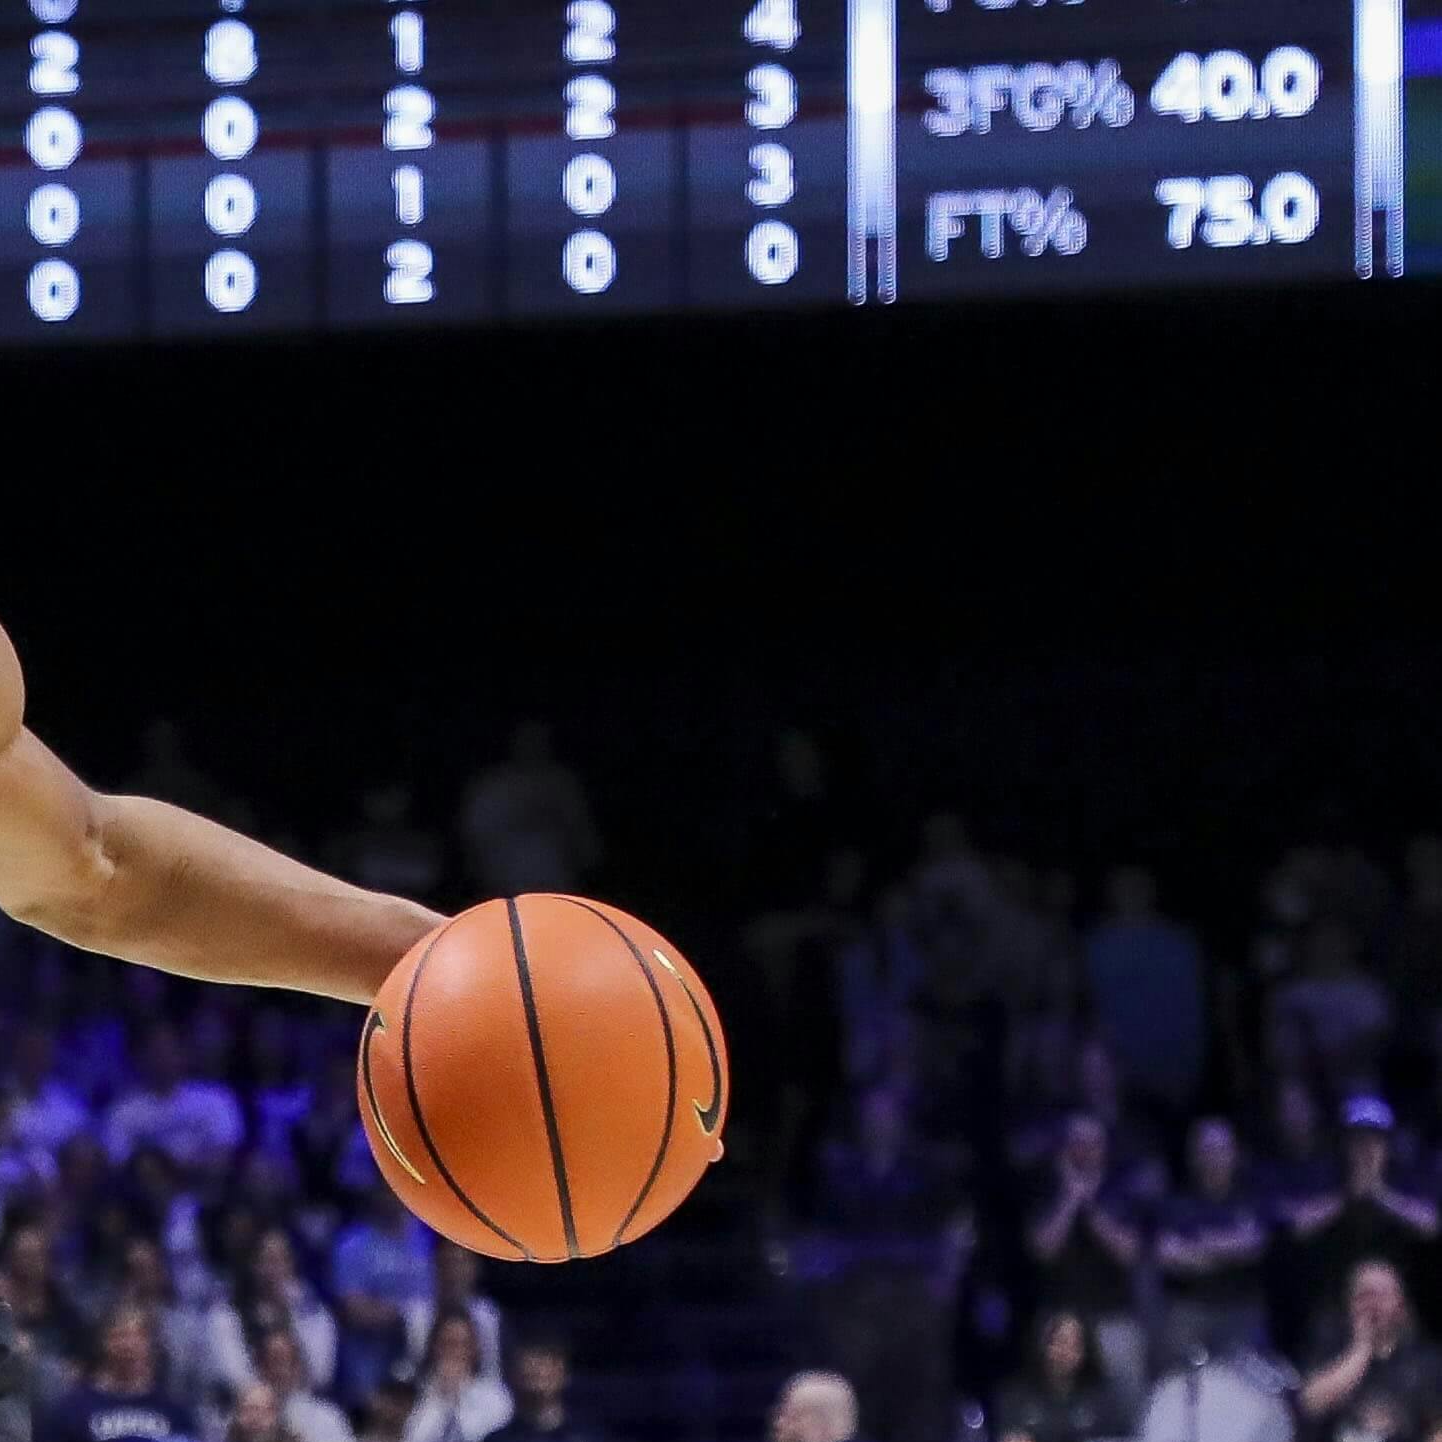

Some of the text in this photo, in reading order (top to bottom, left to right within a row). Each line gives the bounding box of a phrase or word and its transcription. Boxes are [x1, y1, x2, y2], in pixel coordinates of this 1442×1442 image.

[28, 31, 80, 94] 2
[391, 10, 424, 73] 1
[565, 0, 616, 62] 2
[921, 44, 1324, 137] 3FG% 40.0
[26, 106, 82, 171] 0
[203, 96, 259, 161] 0
[384, 86, 434, 151] 2
[565, 75, 616, 141] 2
[746, 64, 797, 130] 3
[28, 183, 80, 246] 0
[203, 172, 257, 237] 0
[392, 165, 424, 226] 1
[562, 153, 617, 217] 0
[746, 143, 795, 207] 3
[924, 170, 1321, 262] FT% 75.0
[28, 258, 80, 323] 0
[203, 248, 257, 313] 0
[384, 240, 434, 305] 2
[563, 229, 617, 295] 0
[746, 220, 799, 285] 0
